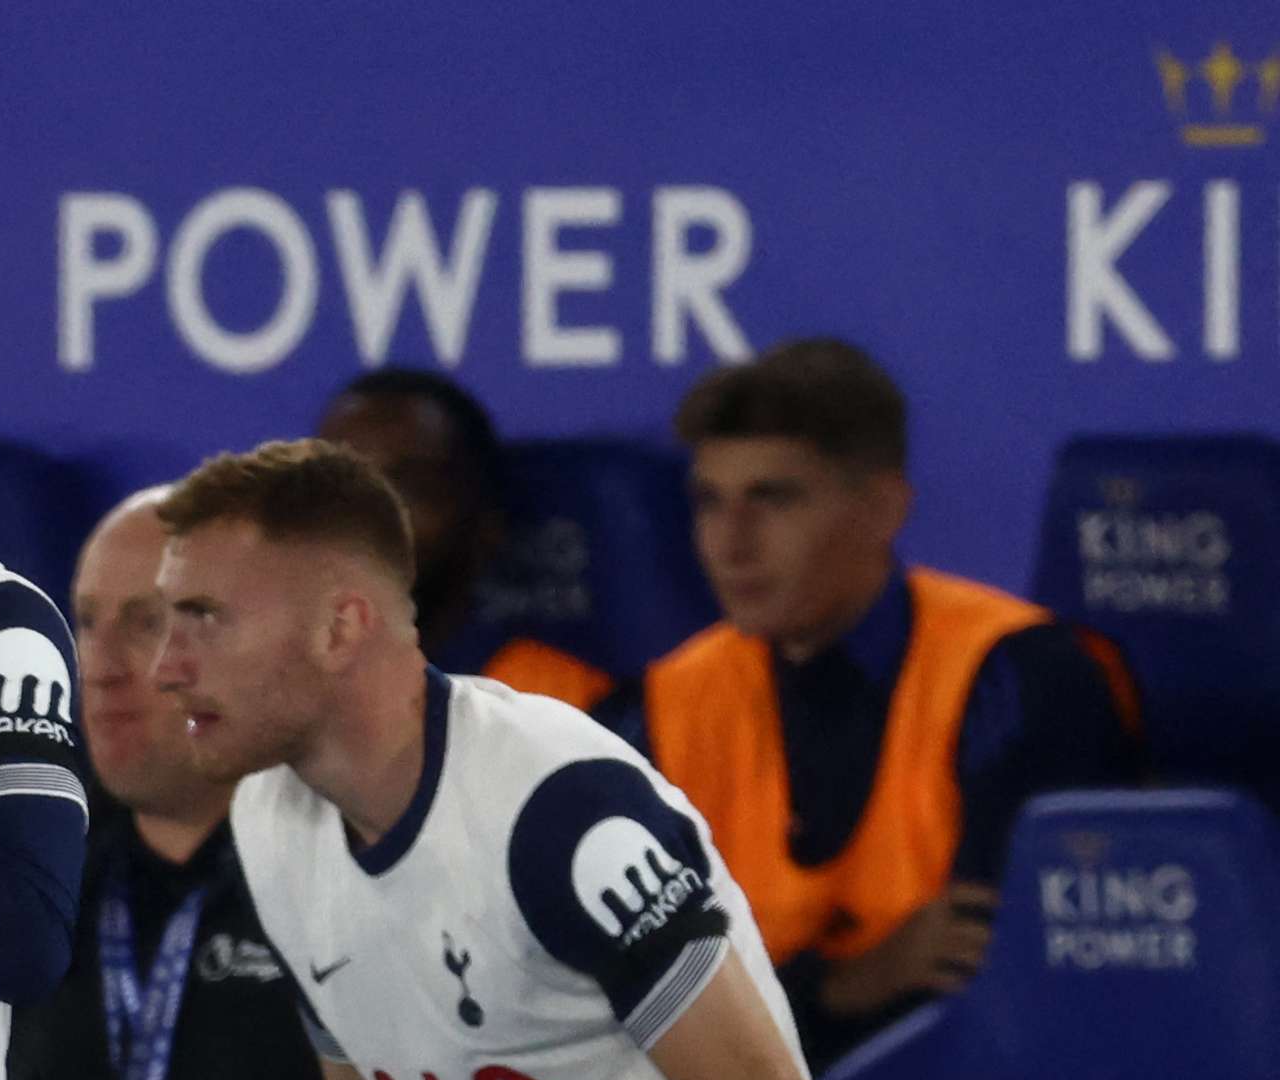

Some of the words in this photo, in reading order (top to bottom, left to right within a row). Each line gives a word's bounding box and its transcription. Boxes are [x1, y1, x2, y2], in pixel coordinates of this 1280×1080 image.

[57, 186, 756, 374] POWER
[1065, 178, 1280, 363] KI
[1040, 865, 1197, 921] KING
